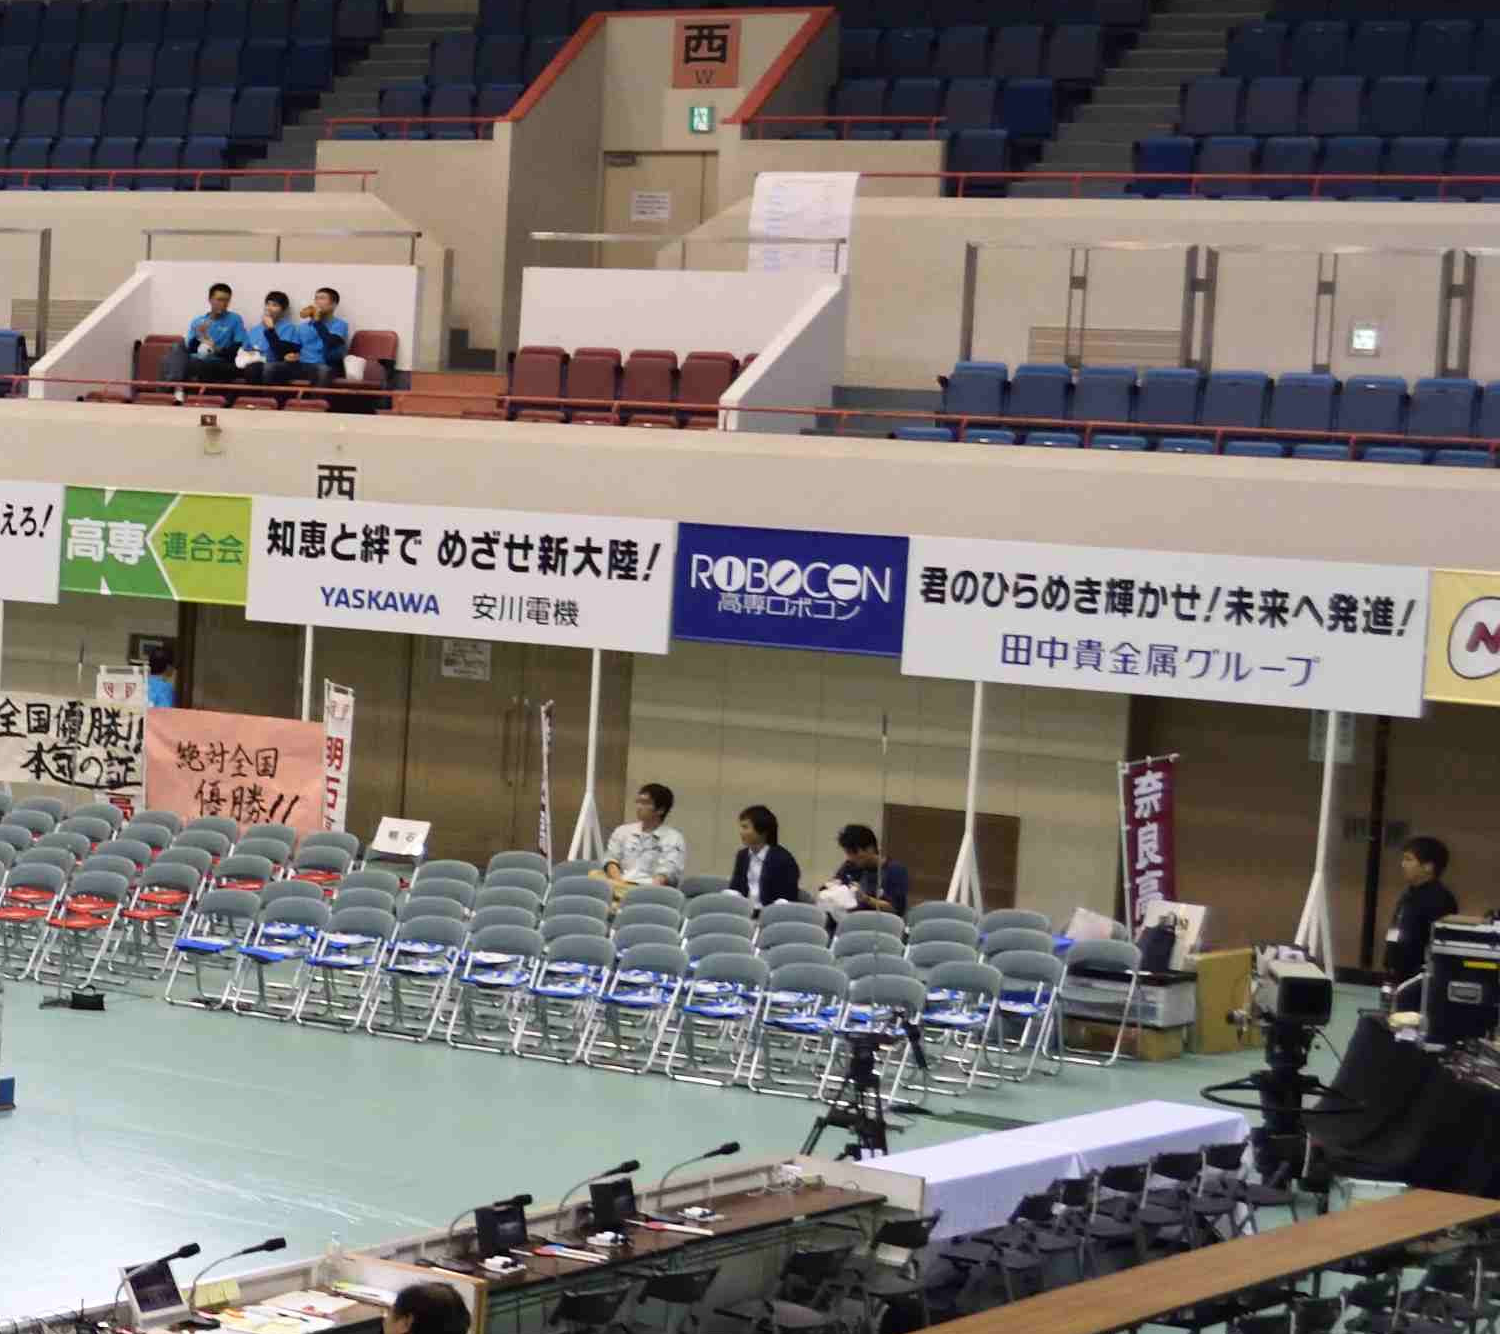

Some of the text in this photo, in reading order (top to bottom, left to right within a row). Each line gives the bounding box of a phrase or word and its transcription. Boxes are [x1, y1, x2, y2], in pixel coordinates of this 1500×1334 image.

[684, 24, 730, 63] 西
[694, 70, 716, 85] W
[317, 464, 357, 501] 西
[67, 518, 243, 565] 高専 連合会
[266, 517, 424, 565] 知恵と絆で
[690, 553, 892, 603] ROBOCON
[320, 585, 580, 627] YASKAWA 安川電機
[717, 592, 861, 620] 高専ロボコン
[1001, 633, 1322, 687] 田中貴金属グループ
[177, 739, 279, 779] 絶対全国
